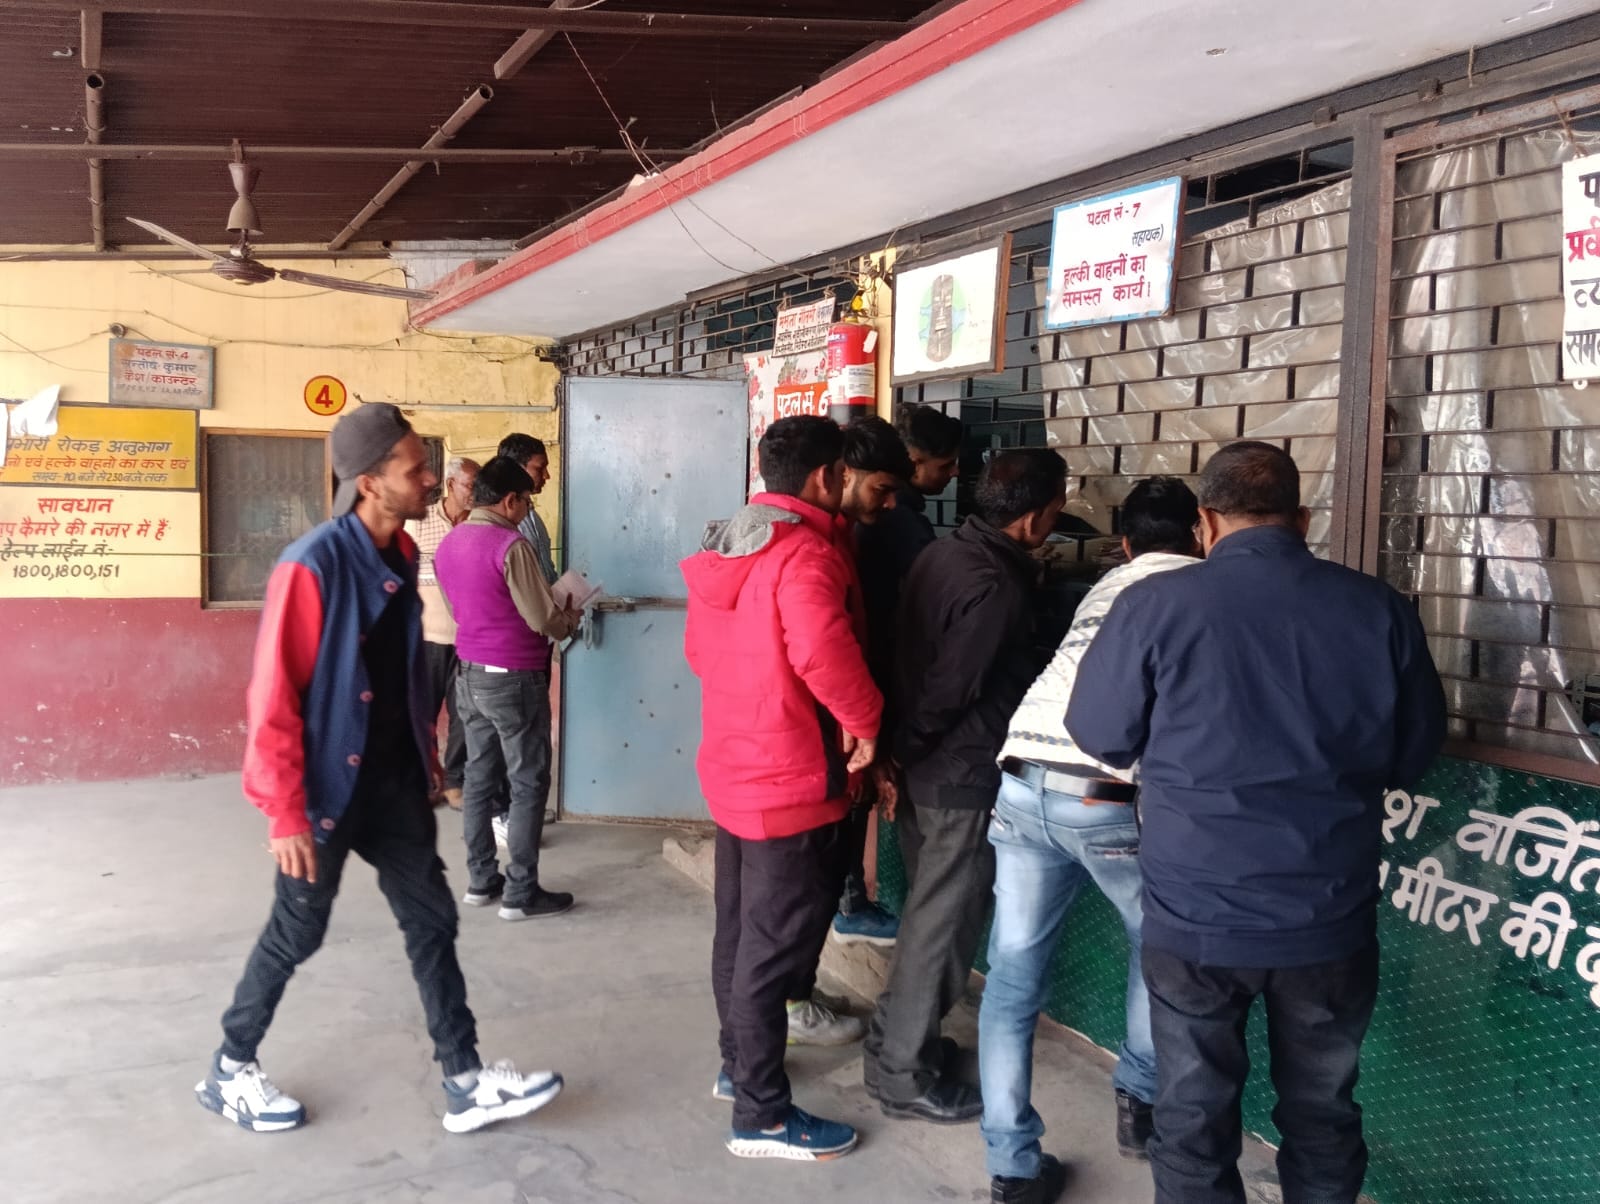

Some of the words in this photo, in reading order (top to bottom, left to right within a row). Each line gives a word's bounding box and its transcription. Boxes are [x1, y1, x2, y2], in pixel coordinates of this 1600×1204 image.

[1087, 208, 1111, 226] पटल
[1063, 260, 1091, 290] हल्की
[1130, 255, 1148, 274] का
[1062, 288, 1102, 310] समस्त
[163, 362, 197, 374] कुमार
[151, 374, 197, 386] काउन्टर
[314, 384, 334, 409] 4
[107, 440, 173, 455] अनुभाग
[45, 455, 76, 470] हल्के
[119, 458, 140, 469] का
[141, 459, 168, 469] कर
[37, 498, 114, 514] सावधान
[19, 516, 61, 538] कैमरे
[65, 518, 87, 537] की
[91, 522, 133, 538] नजर
[136, 518, 152, 537] में
[0, 538, 39, 561] हेल्प
[41, 539, 88, 562] लाईन
[1392, 856, 1499, 946] मीटर
[1500, 891, 1577, 970] की
